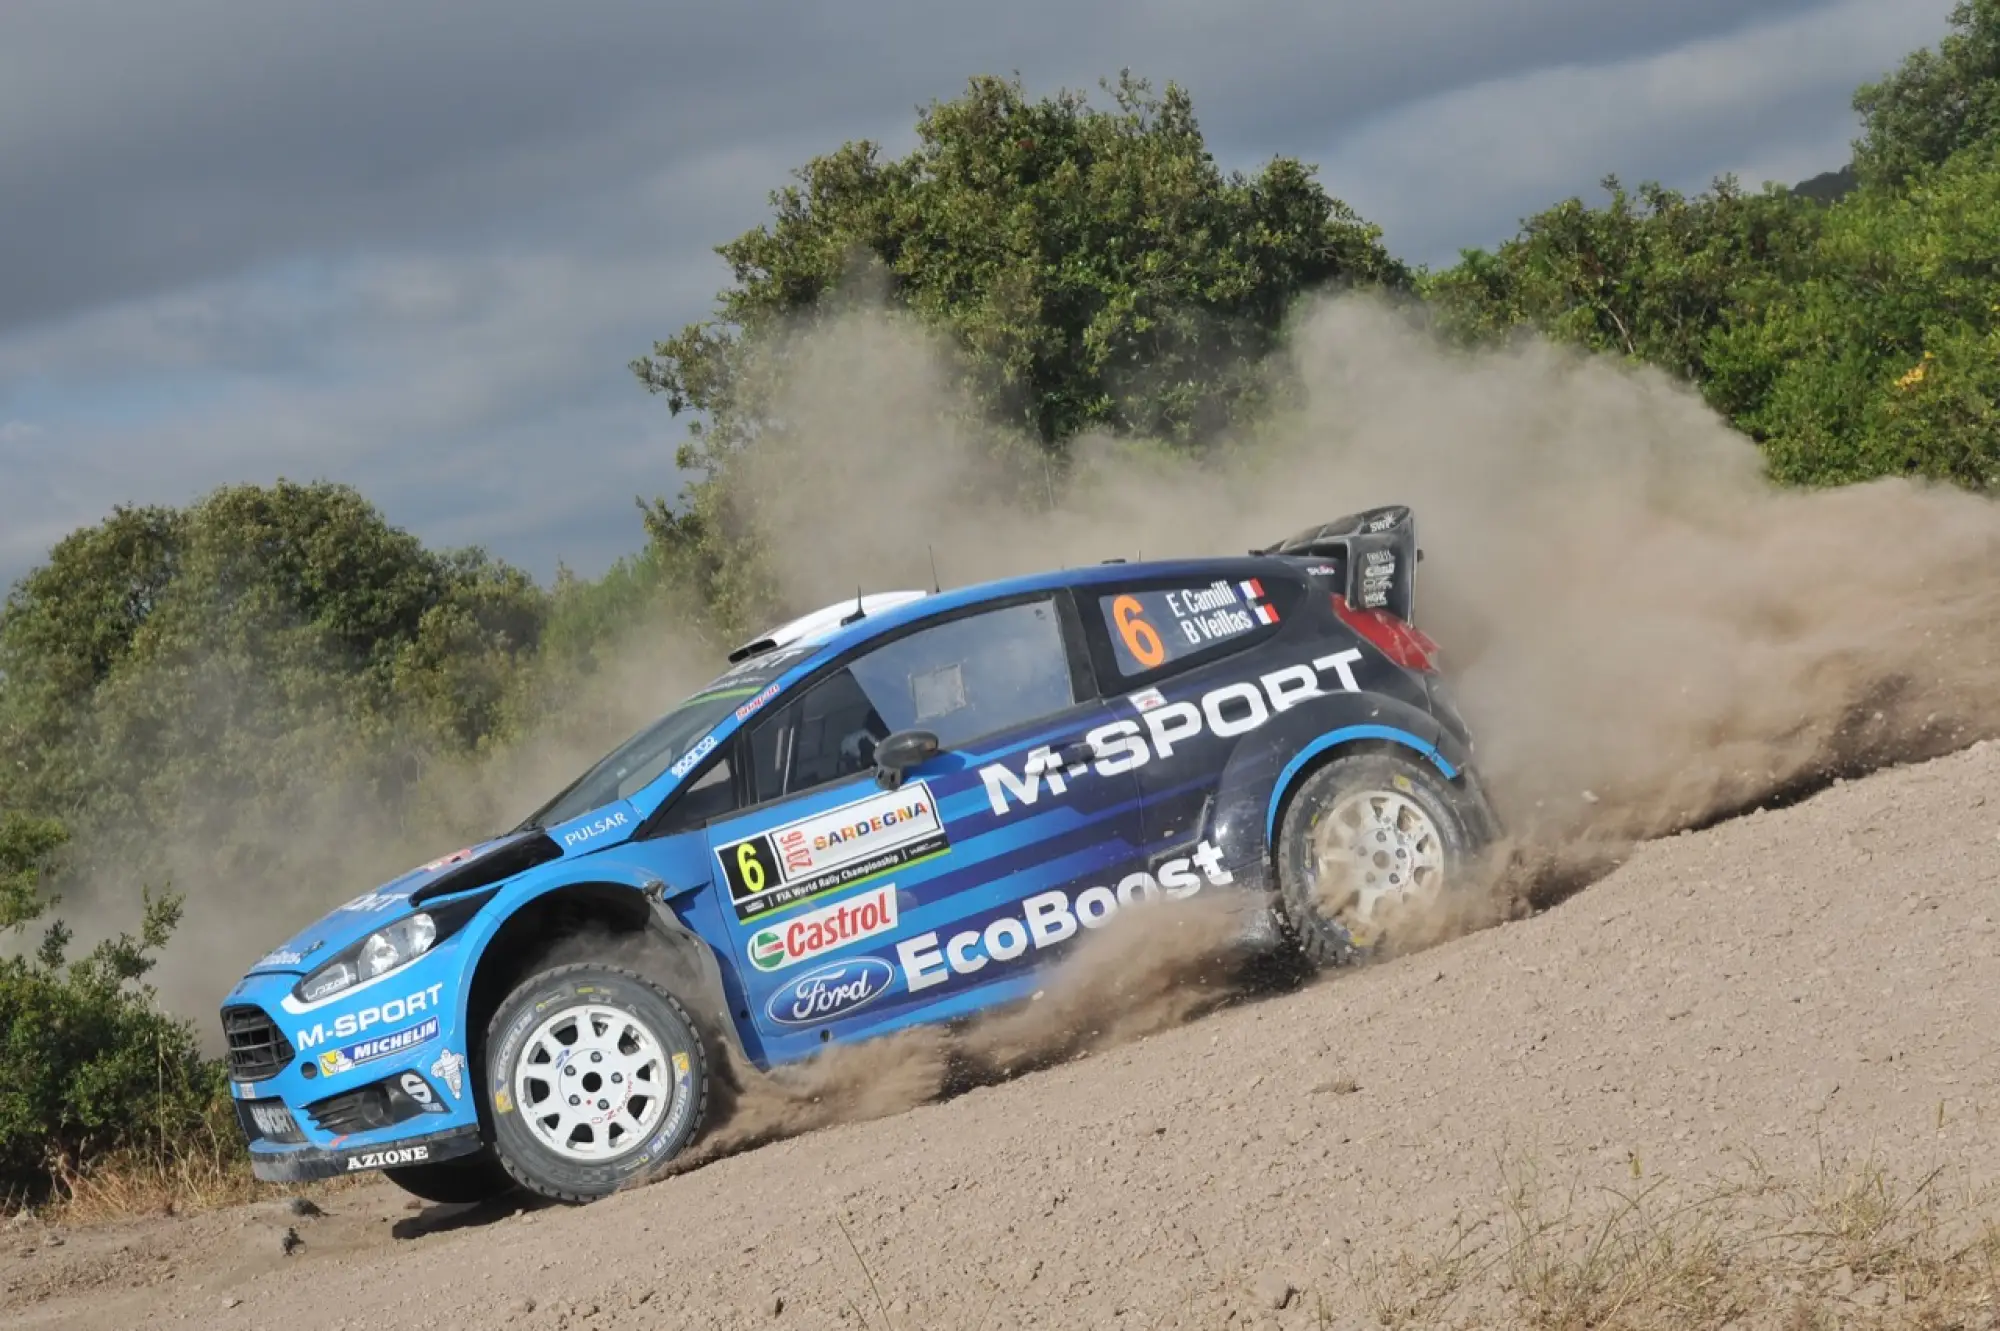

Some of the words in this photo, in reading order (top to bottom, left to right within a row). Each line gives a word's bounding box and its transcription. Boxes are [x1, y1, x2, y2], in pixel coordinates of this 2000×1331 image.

[1165, 592, 1185, 618] E
[1180, 579, 1237, 614] Camilli
[1113, 594, 1165, 669] 6
[1180, 619, 1201, 645] B
[1193, 609, 1253, 640] Veillas
[978, 648, 1362, 816] M-SPORT
[564, 811, 629, 847] PULSAR
[813, 801, 928, 851] SARDEGNA
[736, 841, 765, 893] 6
[780, 830, 813, 873] 2016
[776, 887, 793, 903] FIA
[793, 881, 818, 898] World
[818, 873, 840, 892] Rally
[841, 854, 900, 882] Championship
[786, 890, 891, 958] Castrol
[895, 839, 1234, 993] EcoBoost
[793, 964, 873, 1017] Ford
[296, 982, 443, 1051] M-SPORT
[353, 1019, 438, 1060] MICHELIN
[347, 1146, 429, 1171] AZIONE
